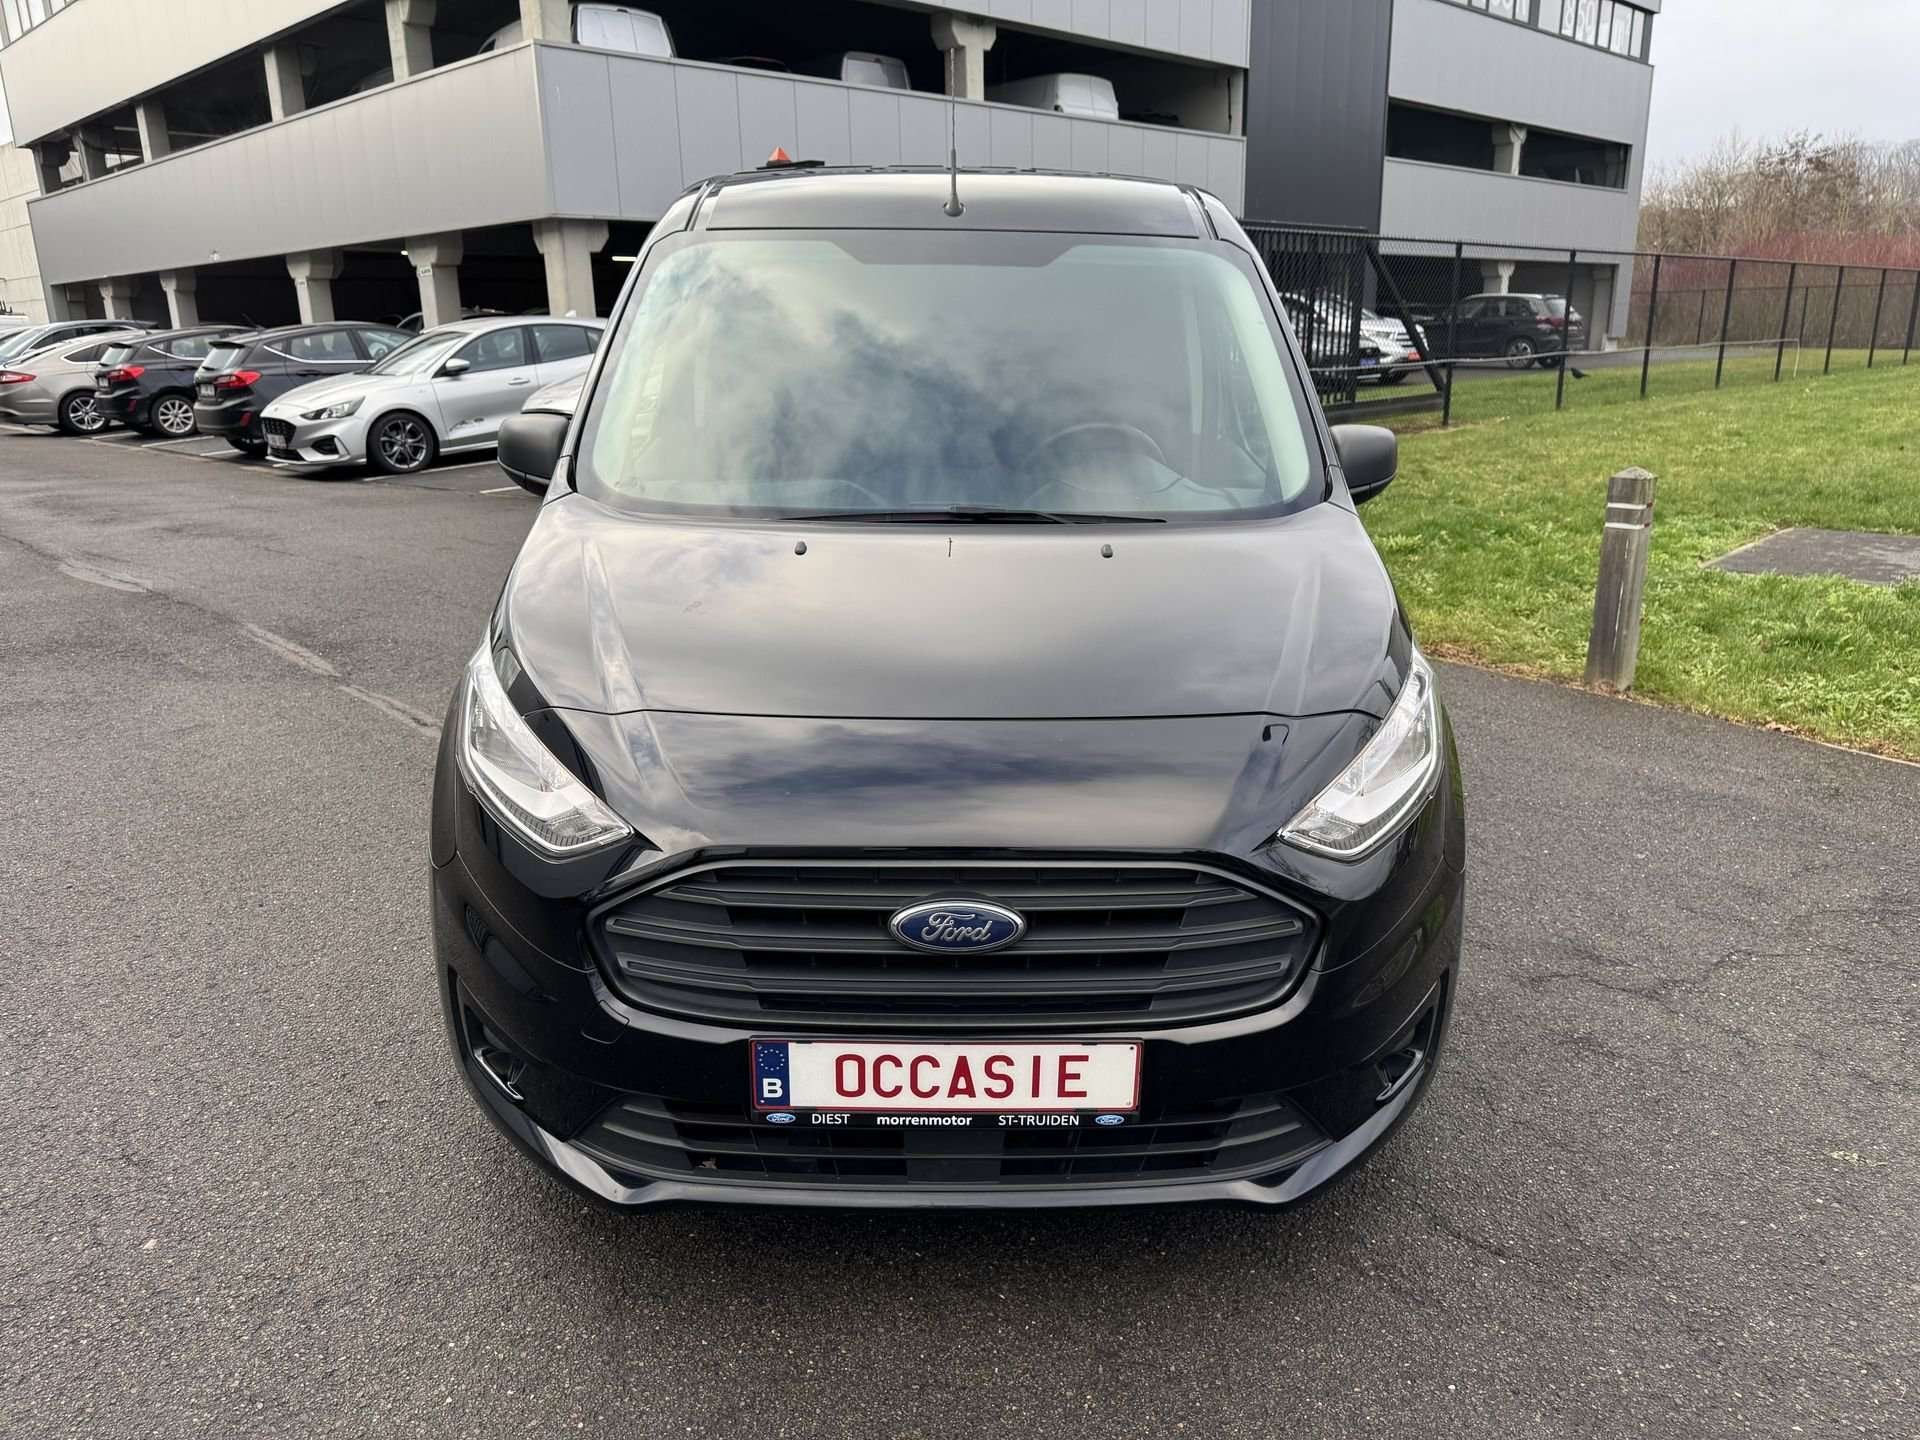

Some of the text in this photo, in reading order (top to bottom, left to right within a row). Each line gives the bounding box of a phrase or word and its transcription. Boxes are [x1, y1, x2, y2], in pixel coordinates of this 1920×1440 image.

[921, 912, 993, 942] Ford
[834, 1053, 1090, 1099] OCCASIE
[762, 1077, 783, 1098] B
[811, 1113, 851, 1125] DIEST
[876, 1115, 972, 1126] morrenmotor
[998, 1114, 1080, 1126] ST-TRUIDEN
